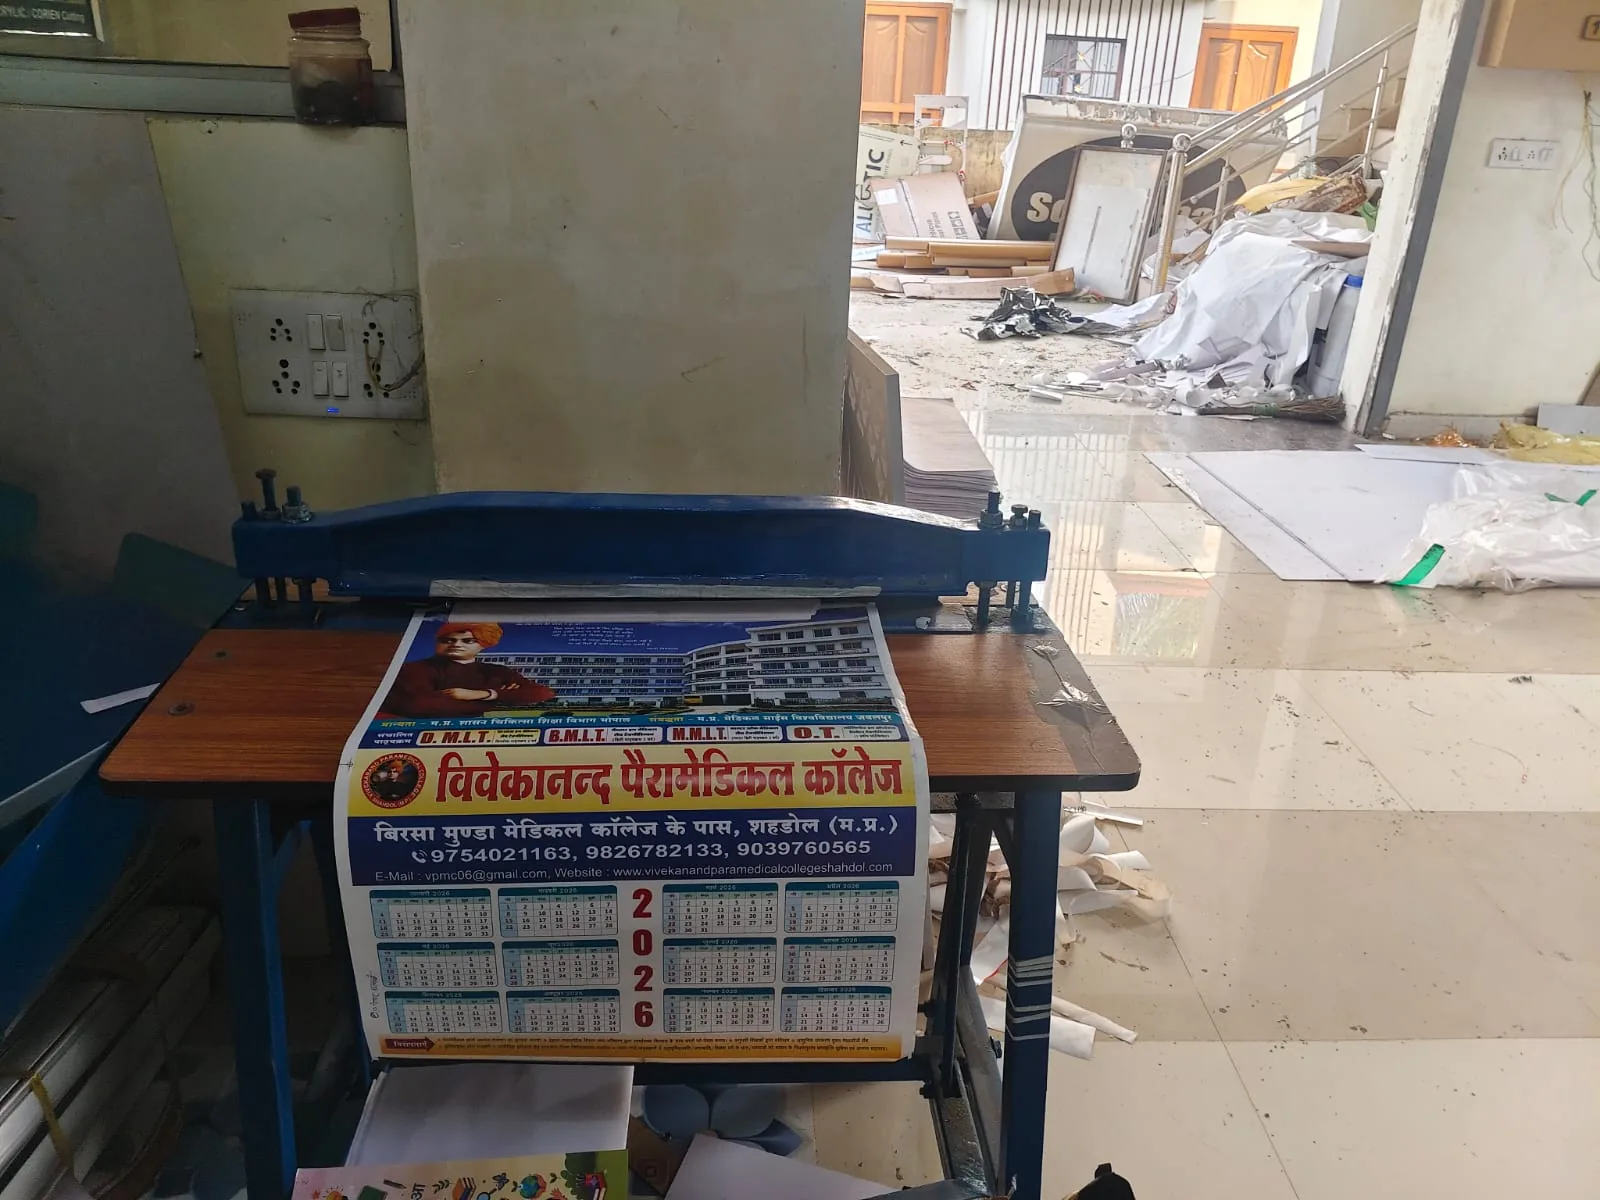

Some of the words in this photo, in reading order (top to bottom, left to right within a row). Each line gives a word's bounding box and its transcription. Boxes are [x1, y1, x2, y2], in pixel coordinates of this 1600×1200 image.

[442, 730, 492, 744] M.L.T.
[549, 728, 607, 742] B.M.L.T.
[672, 726, 727, 740] M.M.L.T.
[793, 726, 840, 740] O.T.
[435, 751, 614, 804] विवेकानन्द
[620, 748, 795, 799] पैरामेडिकल
[802, 746, 903, 796] कॉलेज
[374, 821, 436, 843] बिरसा
[442, 824, 496, 847] मुण्डा
[504, 818, 583, 840] मेडिकल
[590, 816, 658, 838] कॉलेज
[665, 815, 686, 836] के
[693, 819, 740, 838] पास,
[749, 812, 819, 836] शहडोल
[828, 814, 898, 836] (म.प्र.)
[431, 846, 577, 864] 9754021163,
[586, 843, 729, 861] 9826782133,
[737, 840, 871, 857] 9039760565
[375, 871, 414, 882] E-Mail
[555, 866, 603, 879] Website
[613, 862, 893, 878] www.vivekanandparamedicalcollegeshahdol.com
